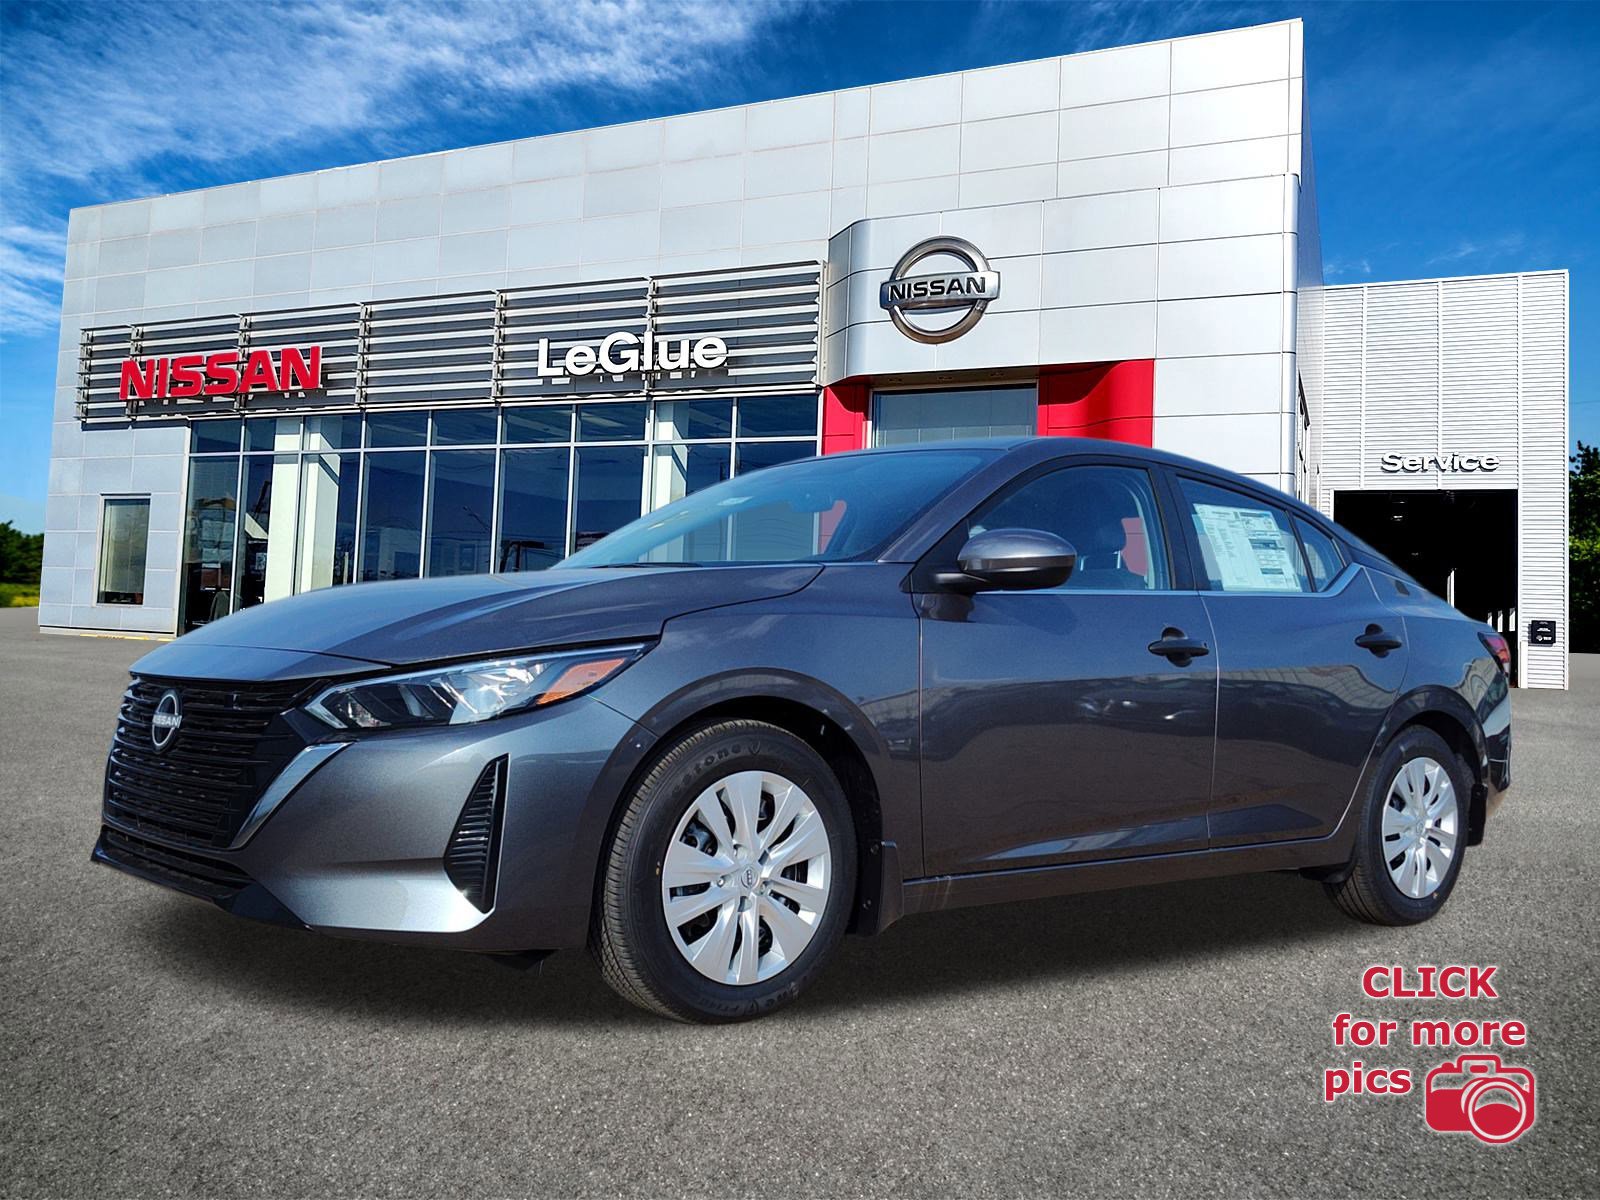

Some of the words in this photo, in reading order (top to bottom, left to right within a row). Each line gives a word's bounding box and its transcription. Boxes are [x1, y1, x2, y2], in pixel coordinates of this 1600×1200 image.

[888, 277, 986, 301] NISSAN
[537, 331, 728, 377] LeGlue
[119, 346, 321, 400] NISSAN
[1381, 451, 1500, 473] Service
